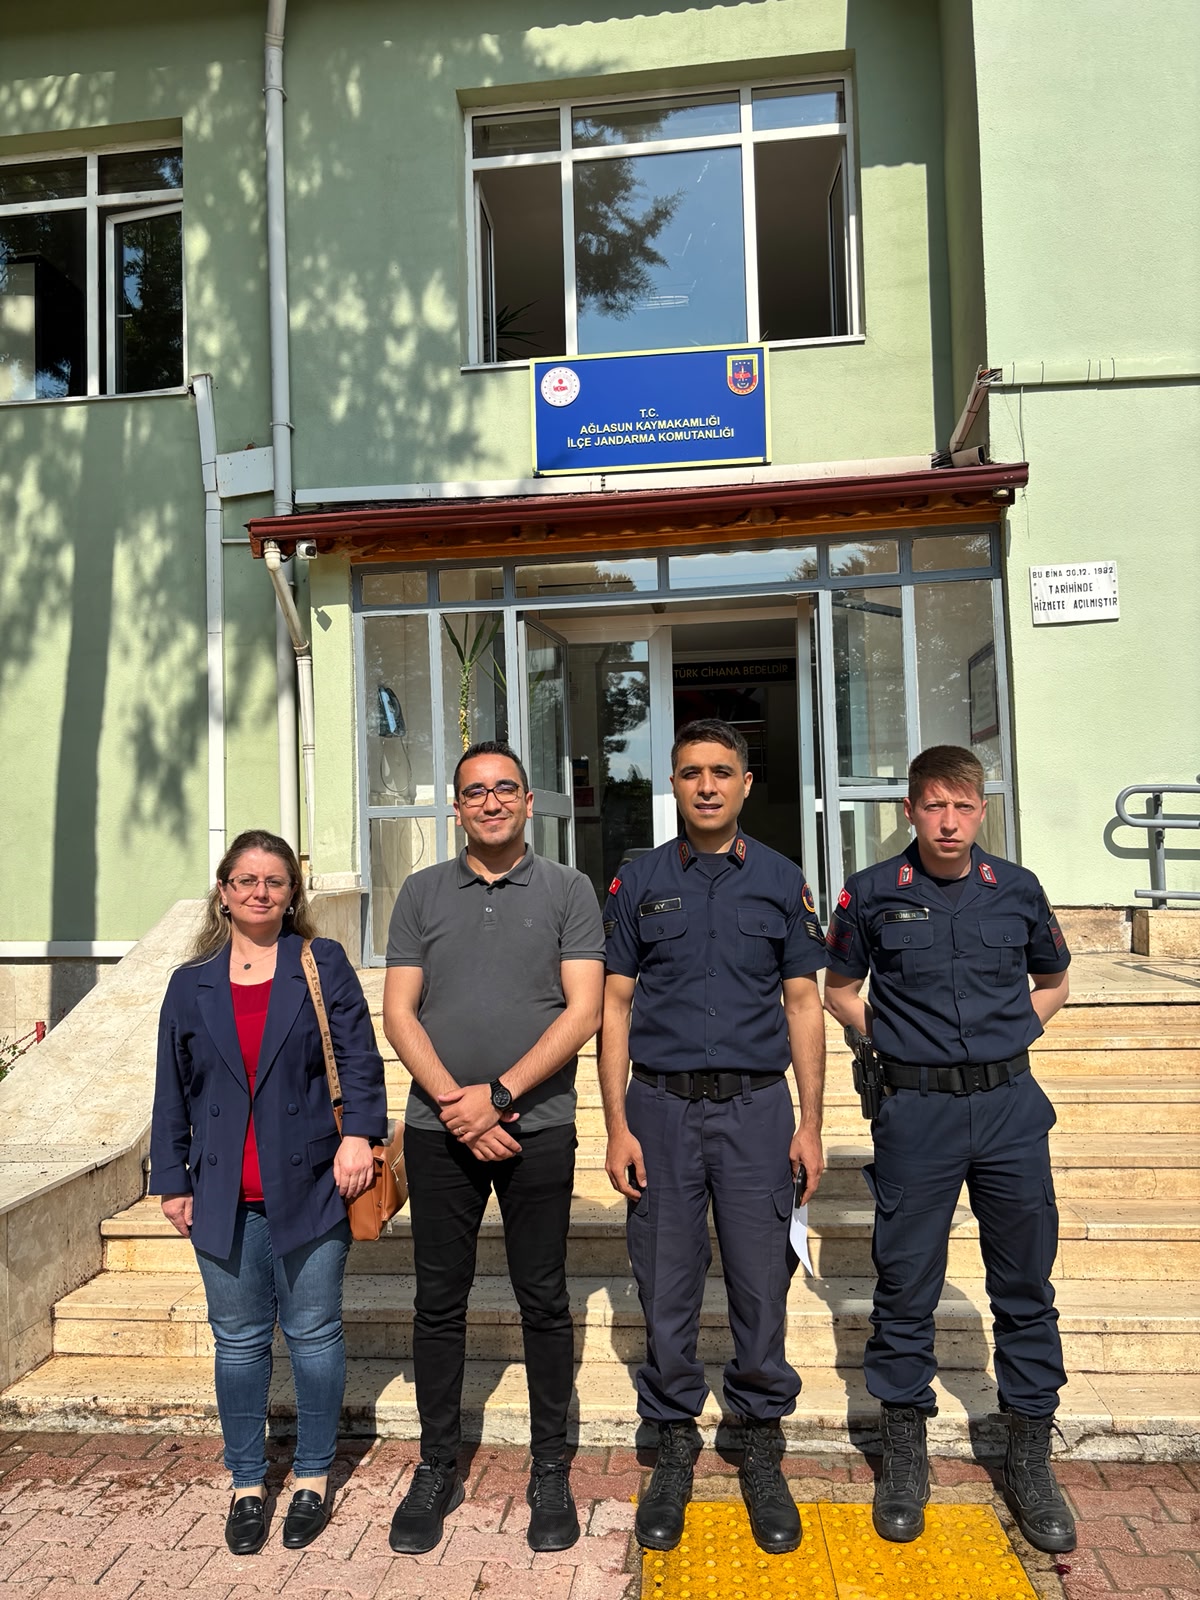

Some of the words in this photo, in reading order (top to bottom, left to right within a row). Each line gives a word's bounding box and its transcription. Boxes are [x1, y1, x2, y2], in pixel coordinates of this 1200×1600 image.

[639, 408, 659, 417] T.C.
[580, 421, 633, 435] AĞLASUN
[636, 415, 720, 431] KAYMAKAMLIĞI
[567, 436, 592, 449] İLÇE
[594, 432, 656, 446] JANDARMA
[658, 428, 735, 442] KOMUTANLIĞI
[1032, 571, 1043, 579] BU
[1048, 582, 1093, 595] TARİHİNDE
[1033, 599, 1066, 612] HİZMETE
[673, 667, 699, 679] TÜRK
[700, 665, 741, 677] CİHANA
[743, 663, 788, 676] BEDELDİR
